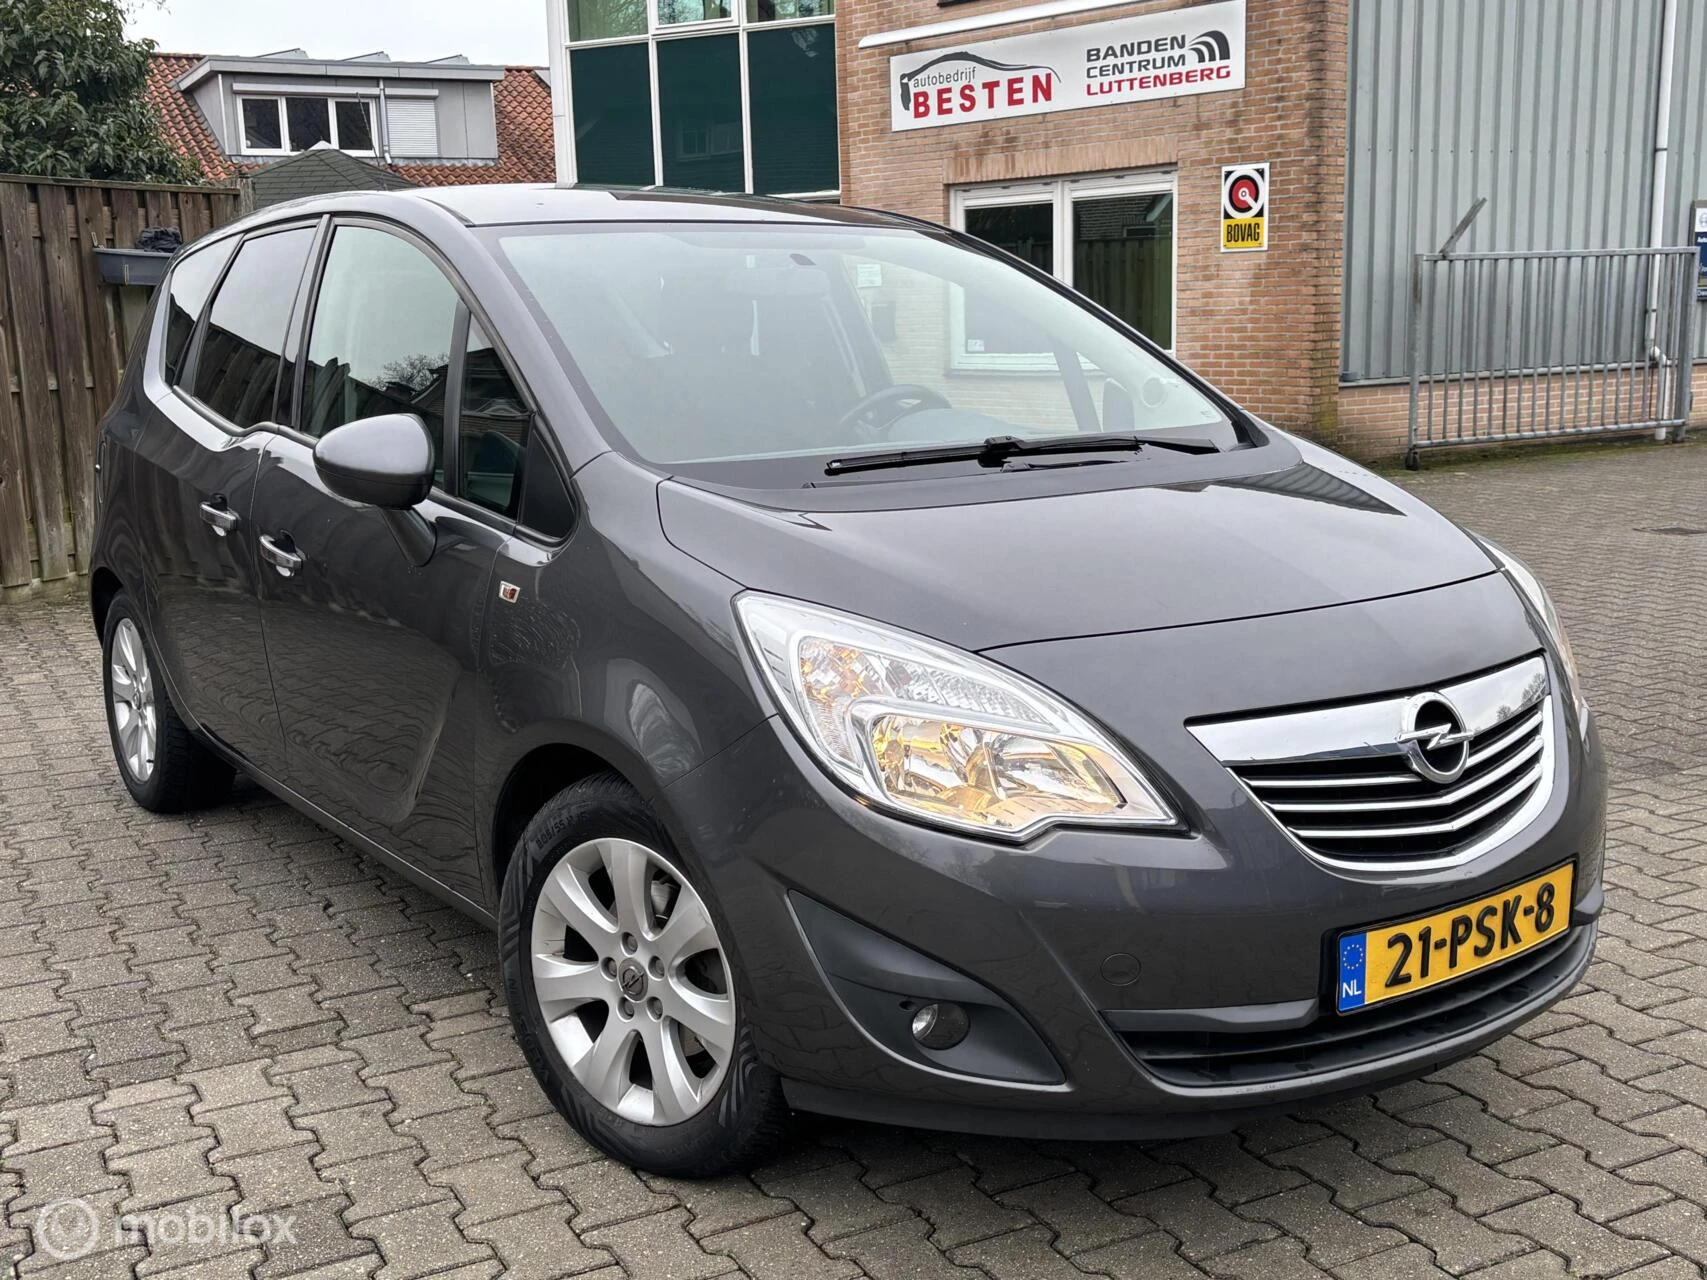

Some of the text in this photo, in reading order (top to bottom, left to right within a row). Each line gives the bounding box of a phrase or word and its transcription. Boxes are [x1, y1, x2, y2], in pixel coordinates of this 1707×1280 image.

[1086, 34, 1186, 62] BANDEN
[913, 66, 976, 88] autobedrijf
[1086, 54, 1186, 78] CENTRUM
[1086, 65, 1231, 96] LUTTENBERG
[913, 72, 1052, 119] BESTEN
[1226, 222, 1260, 242] BOVAG
[1385, 882, 1555, 988] 21-PSK-8
[1342, 979, 1362, 998] NL
